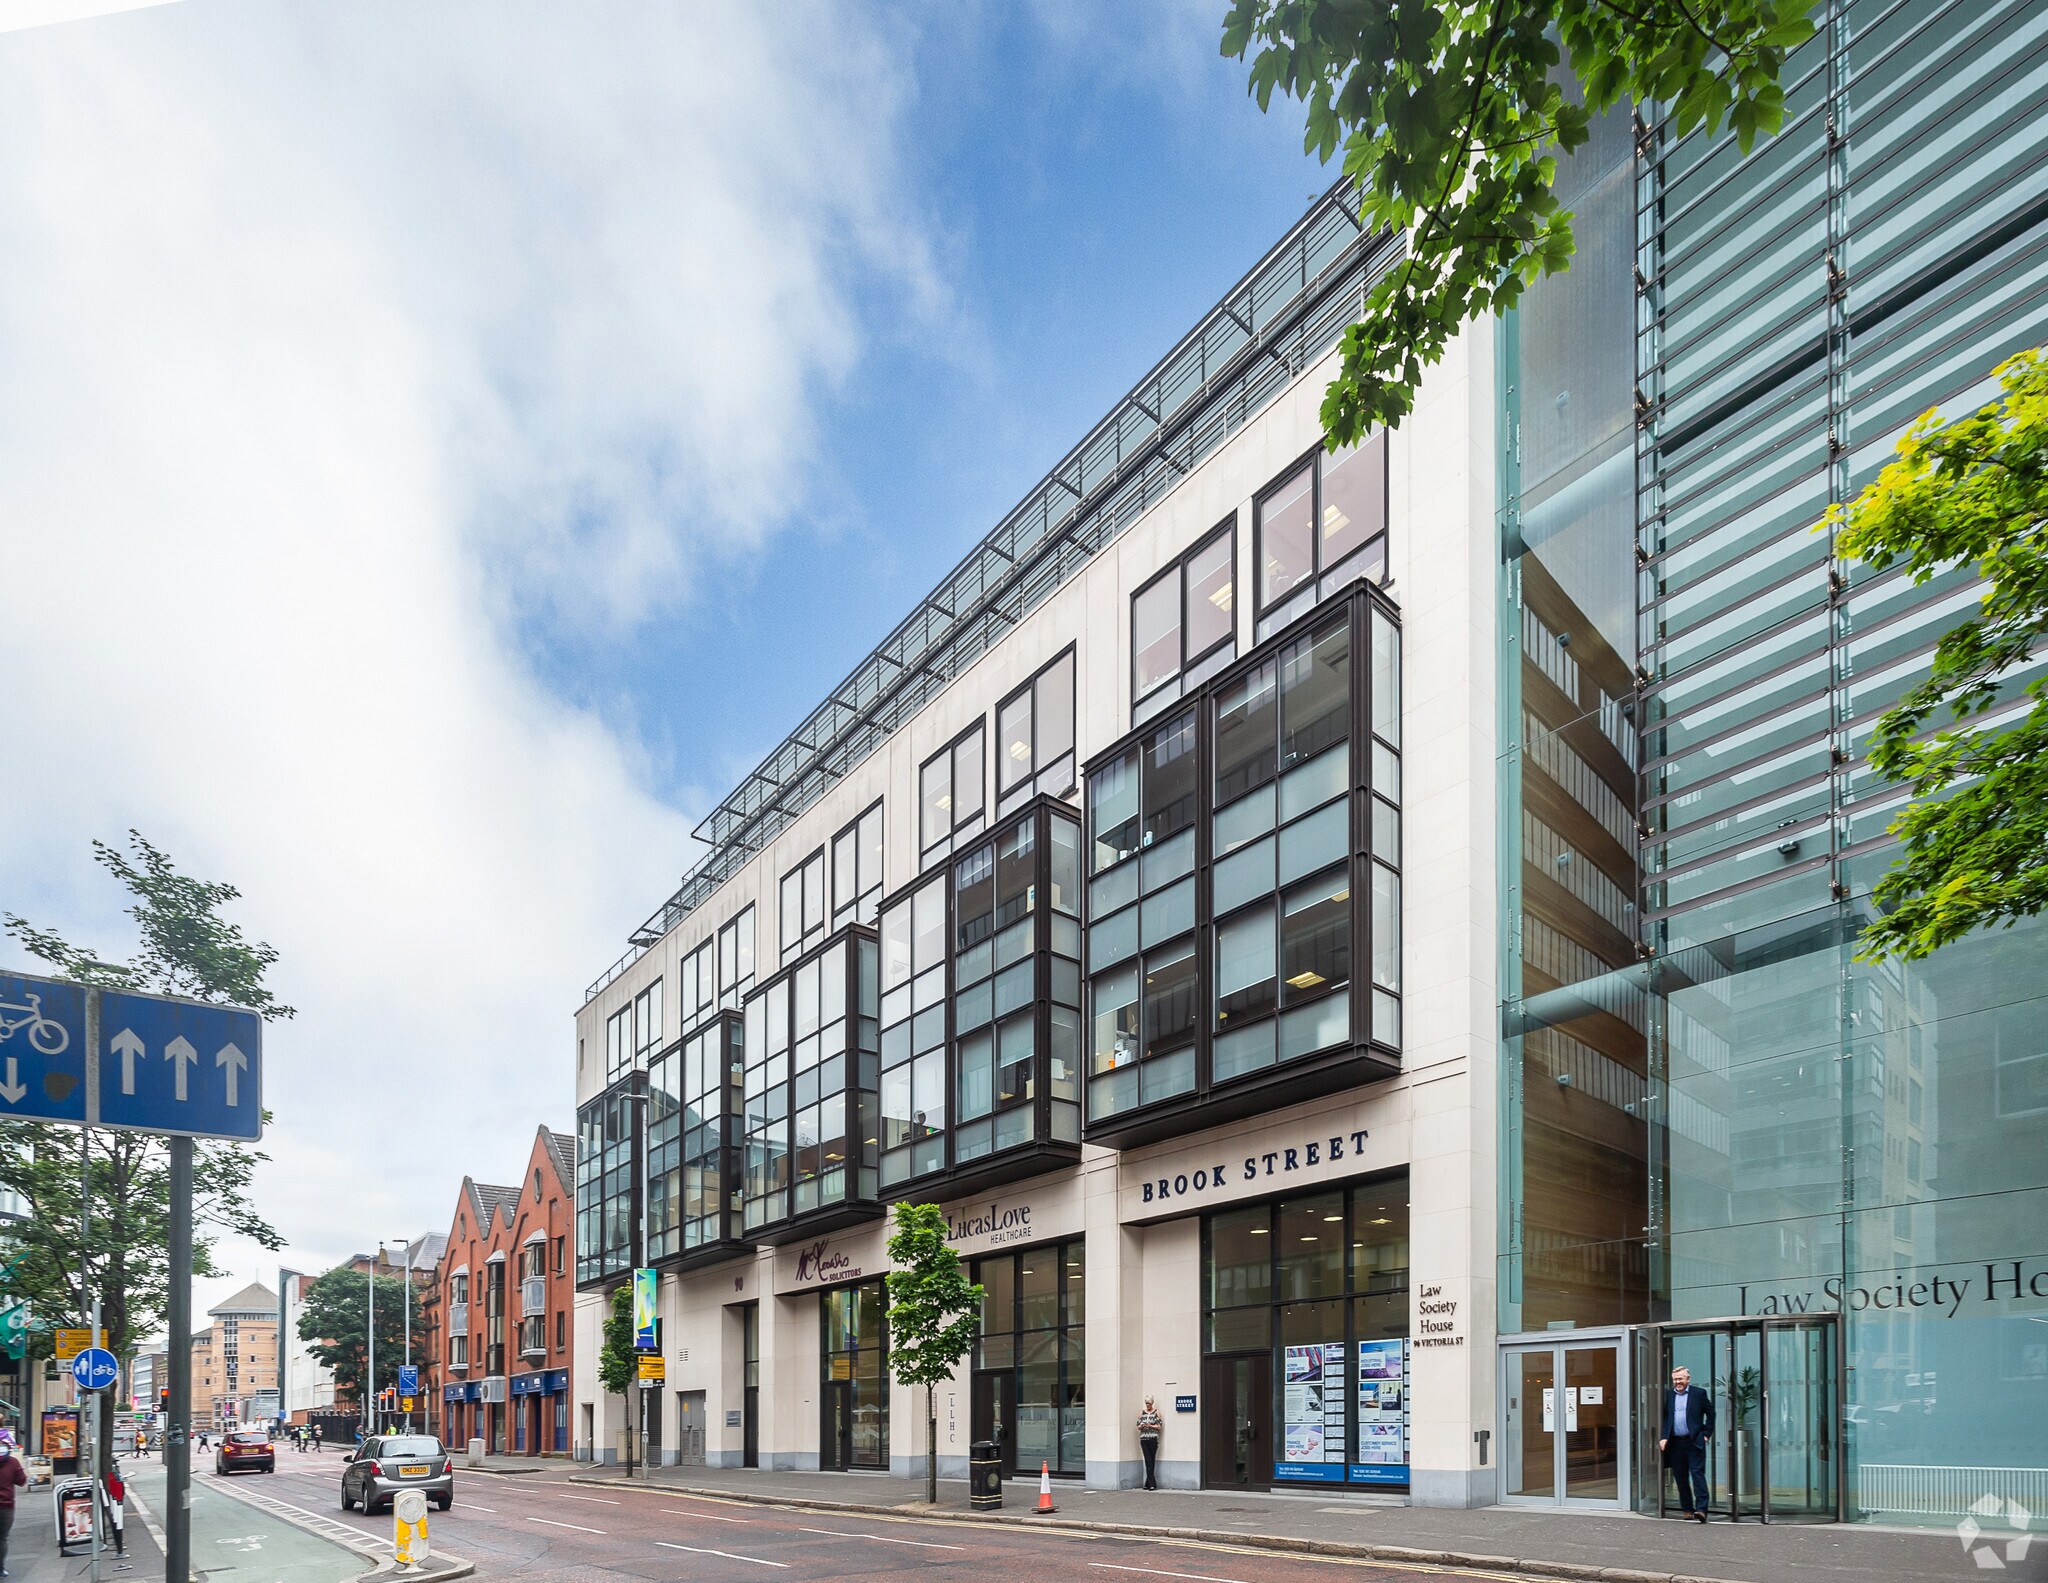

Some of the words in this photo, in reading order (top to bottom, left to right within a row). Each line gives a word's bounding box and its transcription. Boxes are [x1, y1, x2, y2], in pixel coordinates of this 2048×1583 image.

[1142, 1165, 1226, 1202] BROOK
[1244, 1130, 1368, 1180] STREET
[947, 1204, 1031, 1242] LucasLove
[990, 1226, 1032, 1245] HEALTHCARE
[829, 1267, 862, 1282] SOLICITORS
[734, 1275, 744, 1292] 90
[1420, 1284, 1442, 1297] Law
[1737, 1284, 1814, 1316] Law
[1823, 1275, 1973, 1319] Society
[1419, 1300, 1457, 1316] Society
[1420, 1319, 1454, 1334] House
[1421, 1337, 1455, 1347] VICTORIA
[1455, 1336, 1464, 1346] ST
